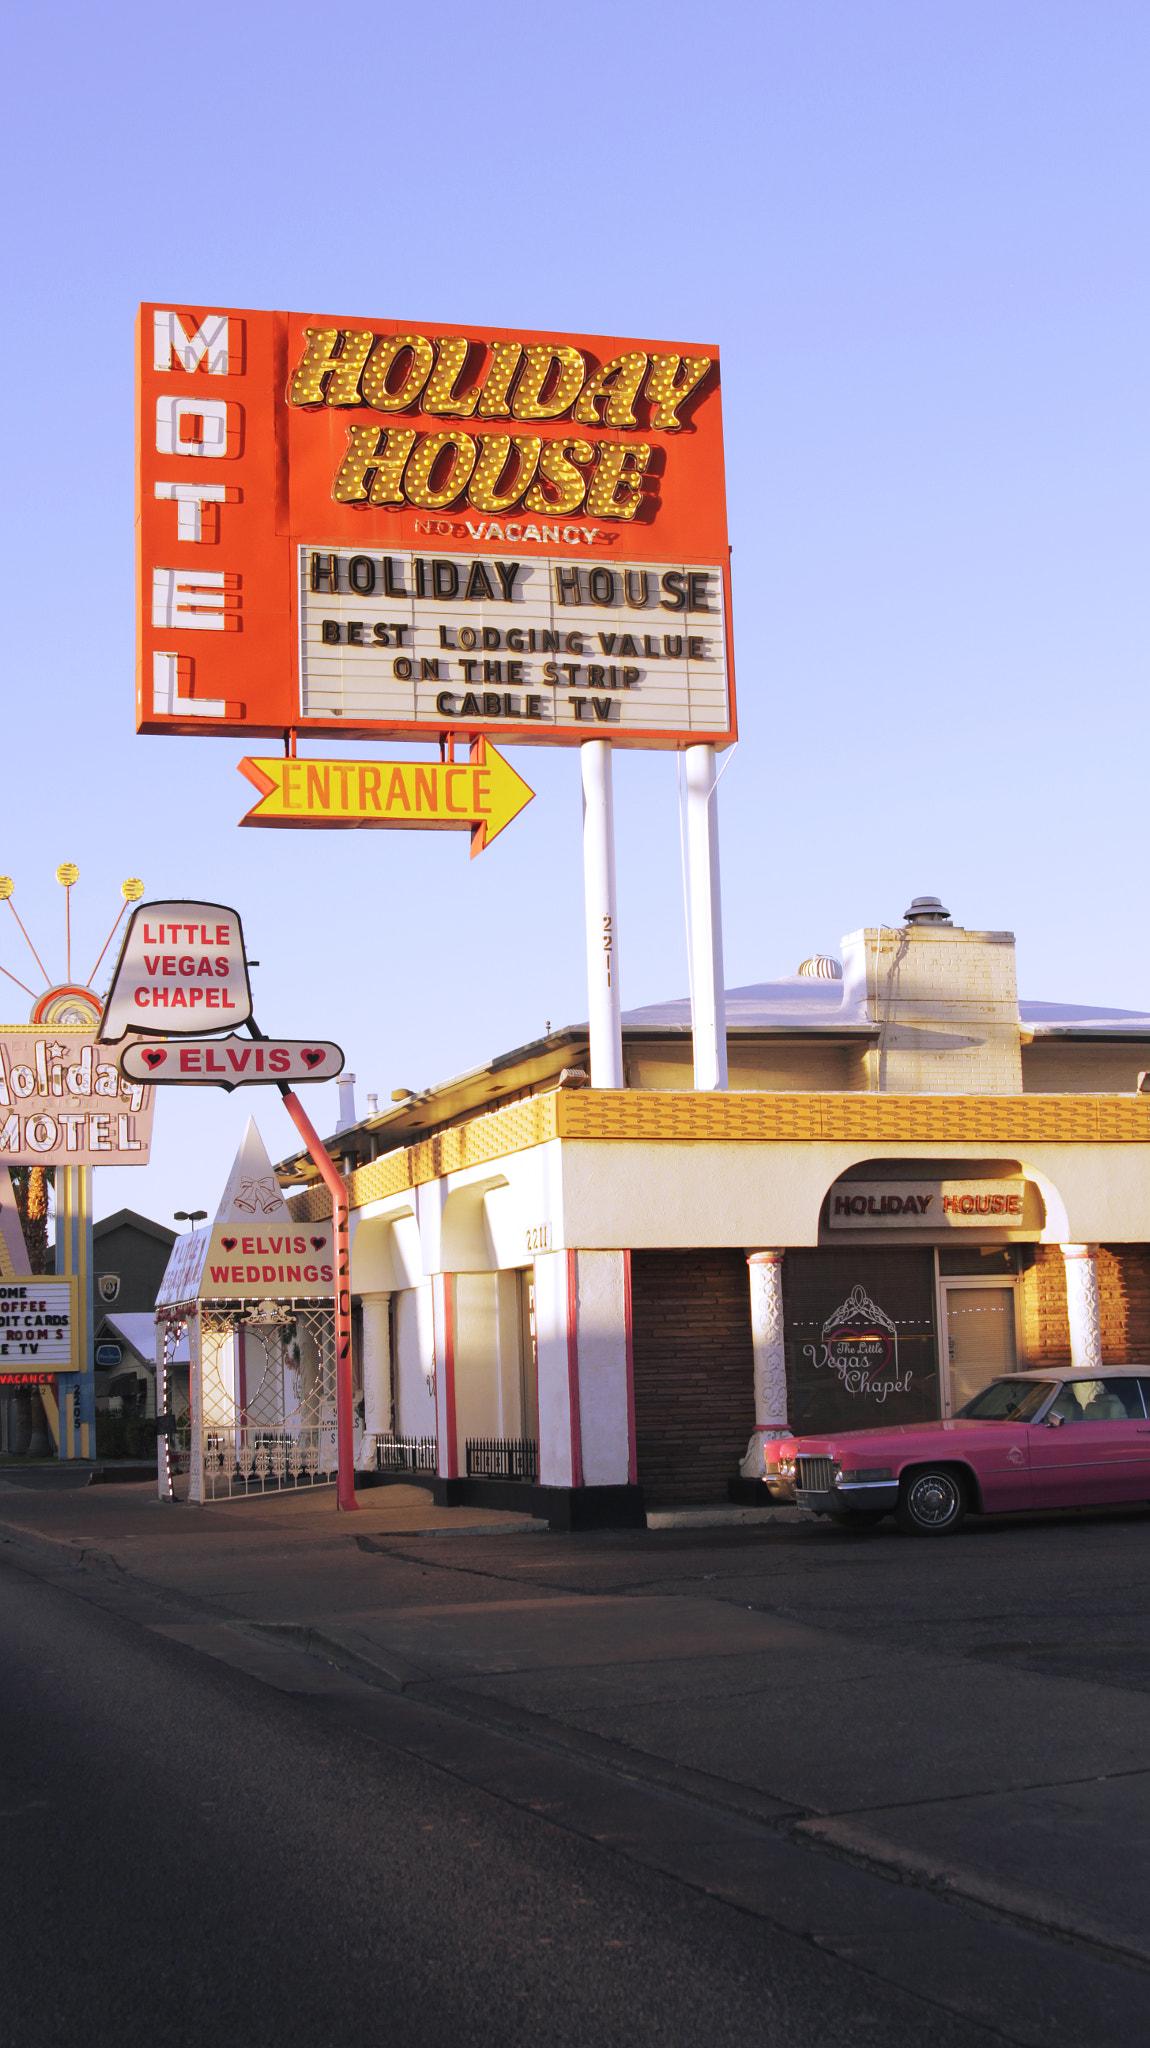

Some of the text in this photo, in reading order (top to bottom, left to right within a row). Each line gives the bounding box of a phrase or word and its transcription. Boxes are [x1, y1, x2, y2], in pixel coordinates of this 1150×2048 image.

[286, 327, 711, 432] HOLIDAY
[332, 424, 652, 521] HOUSE
[153, 310, 229, 717] MOTEL
[465, 521, 600, 545] VACANCY
[310, 552, 710, 613] HOLIDAY HOUSE
[322, 620, 706, 660] BEST LODGING VALUE
[393, 656, 640, 690] ON THE STRIP
[437, 691, 612, 722] CABLE TV
[282, 764, 492, 814] ENTRANCE
[143, 924, 230, 945] LITTLE
[144, 955, 230, 977] VEGAS
[134, 987, 235, 1008] CHAPEL
[180, 1049, 291, 1072] ELVIS
[835, 1195, 1020, 1215] HOLIDAY HOUSE
[242, 1237, 306, 1254] ELVIS
[526, 1225, 547, 1250] 2211
[210, 1265, 334, 1283] WEDDINGS
[337, 1206, 350, 1359] 2207
[24, 1315, 69, 1326] CARDS
[19, 1343, 39, 1354] TV
[837, 1342, 883, 1354] The Little
[803, 1344, 871, 1380] Vegas
[0, 1374, 53, 1384] VACANCY
[845, 1370, 912, 1403] Chapel
[73, 1384, 81, 1429] 2205
